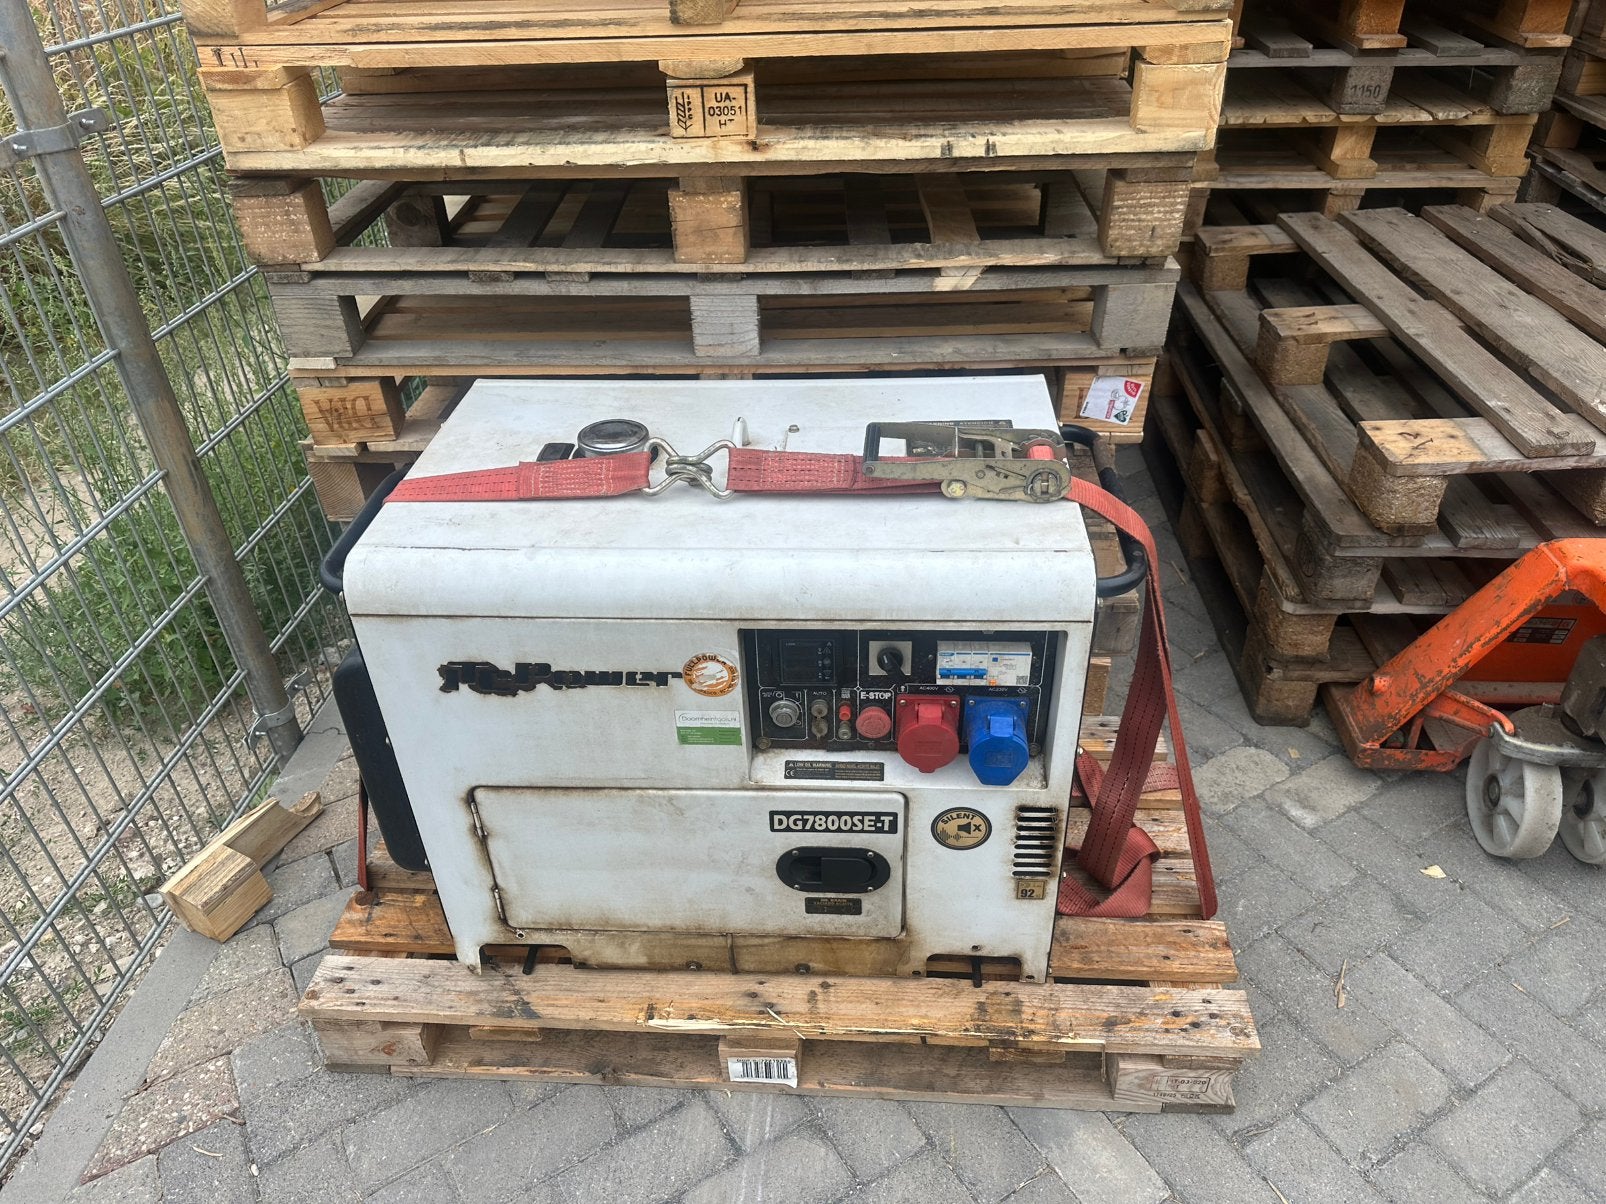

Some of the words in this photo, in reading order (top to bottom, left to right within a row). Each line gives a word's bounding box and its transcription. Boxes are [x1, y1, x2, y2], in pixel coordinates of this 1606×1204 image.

[1350, 84, 1381, 98] 1150
[714, 92, 736, 103] UA-
[708, 105, 742, 116] 03051
[860, 692, 892, 700] E-STOP
[773, 814, 894, 831] DG7800SE-T
[941, 812, 976, 825] SILENT
[1020, 889, 1035, 898] 92
